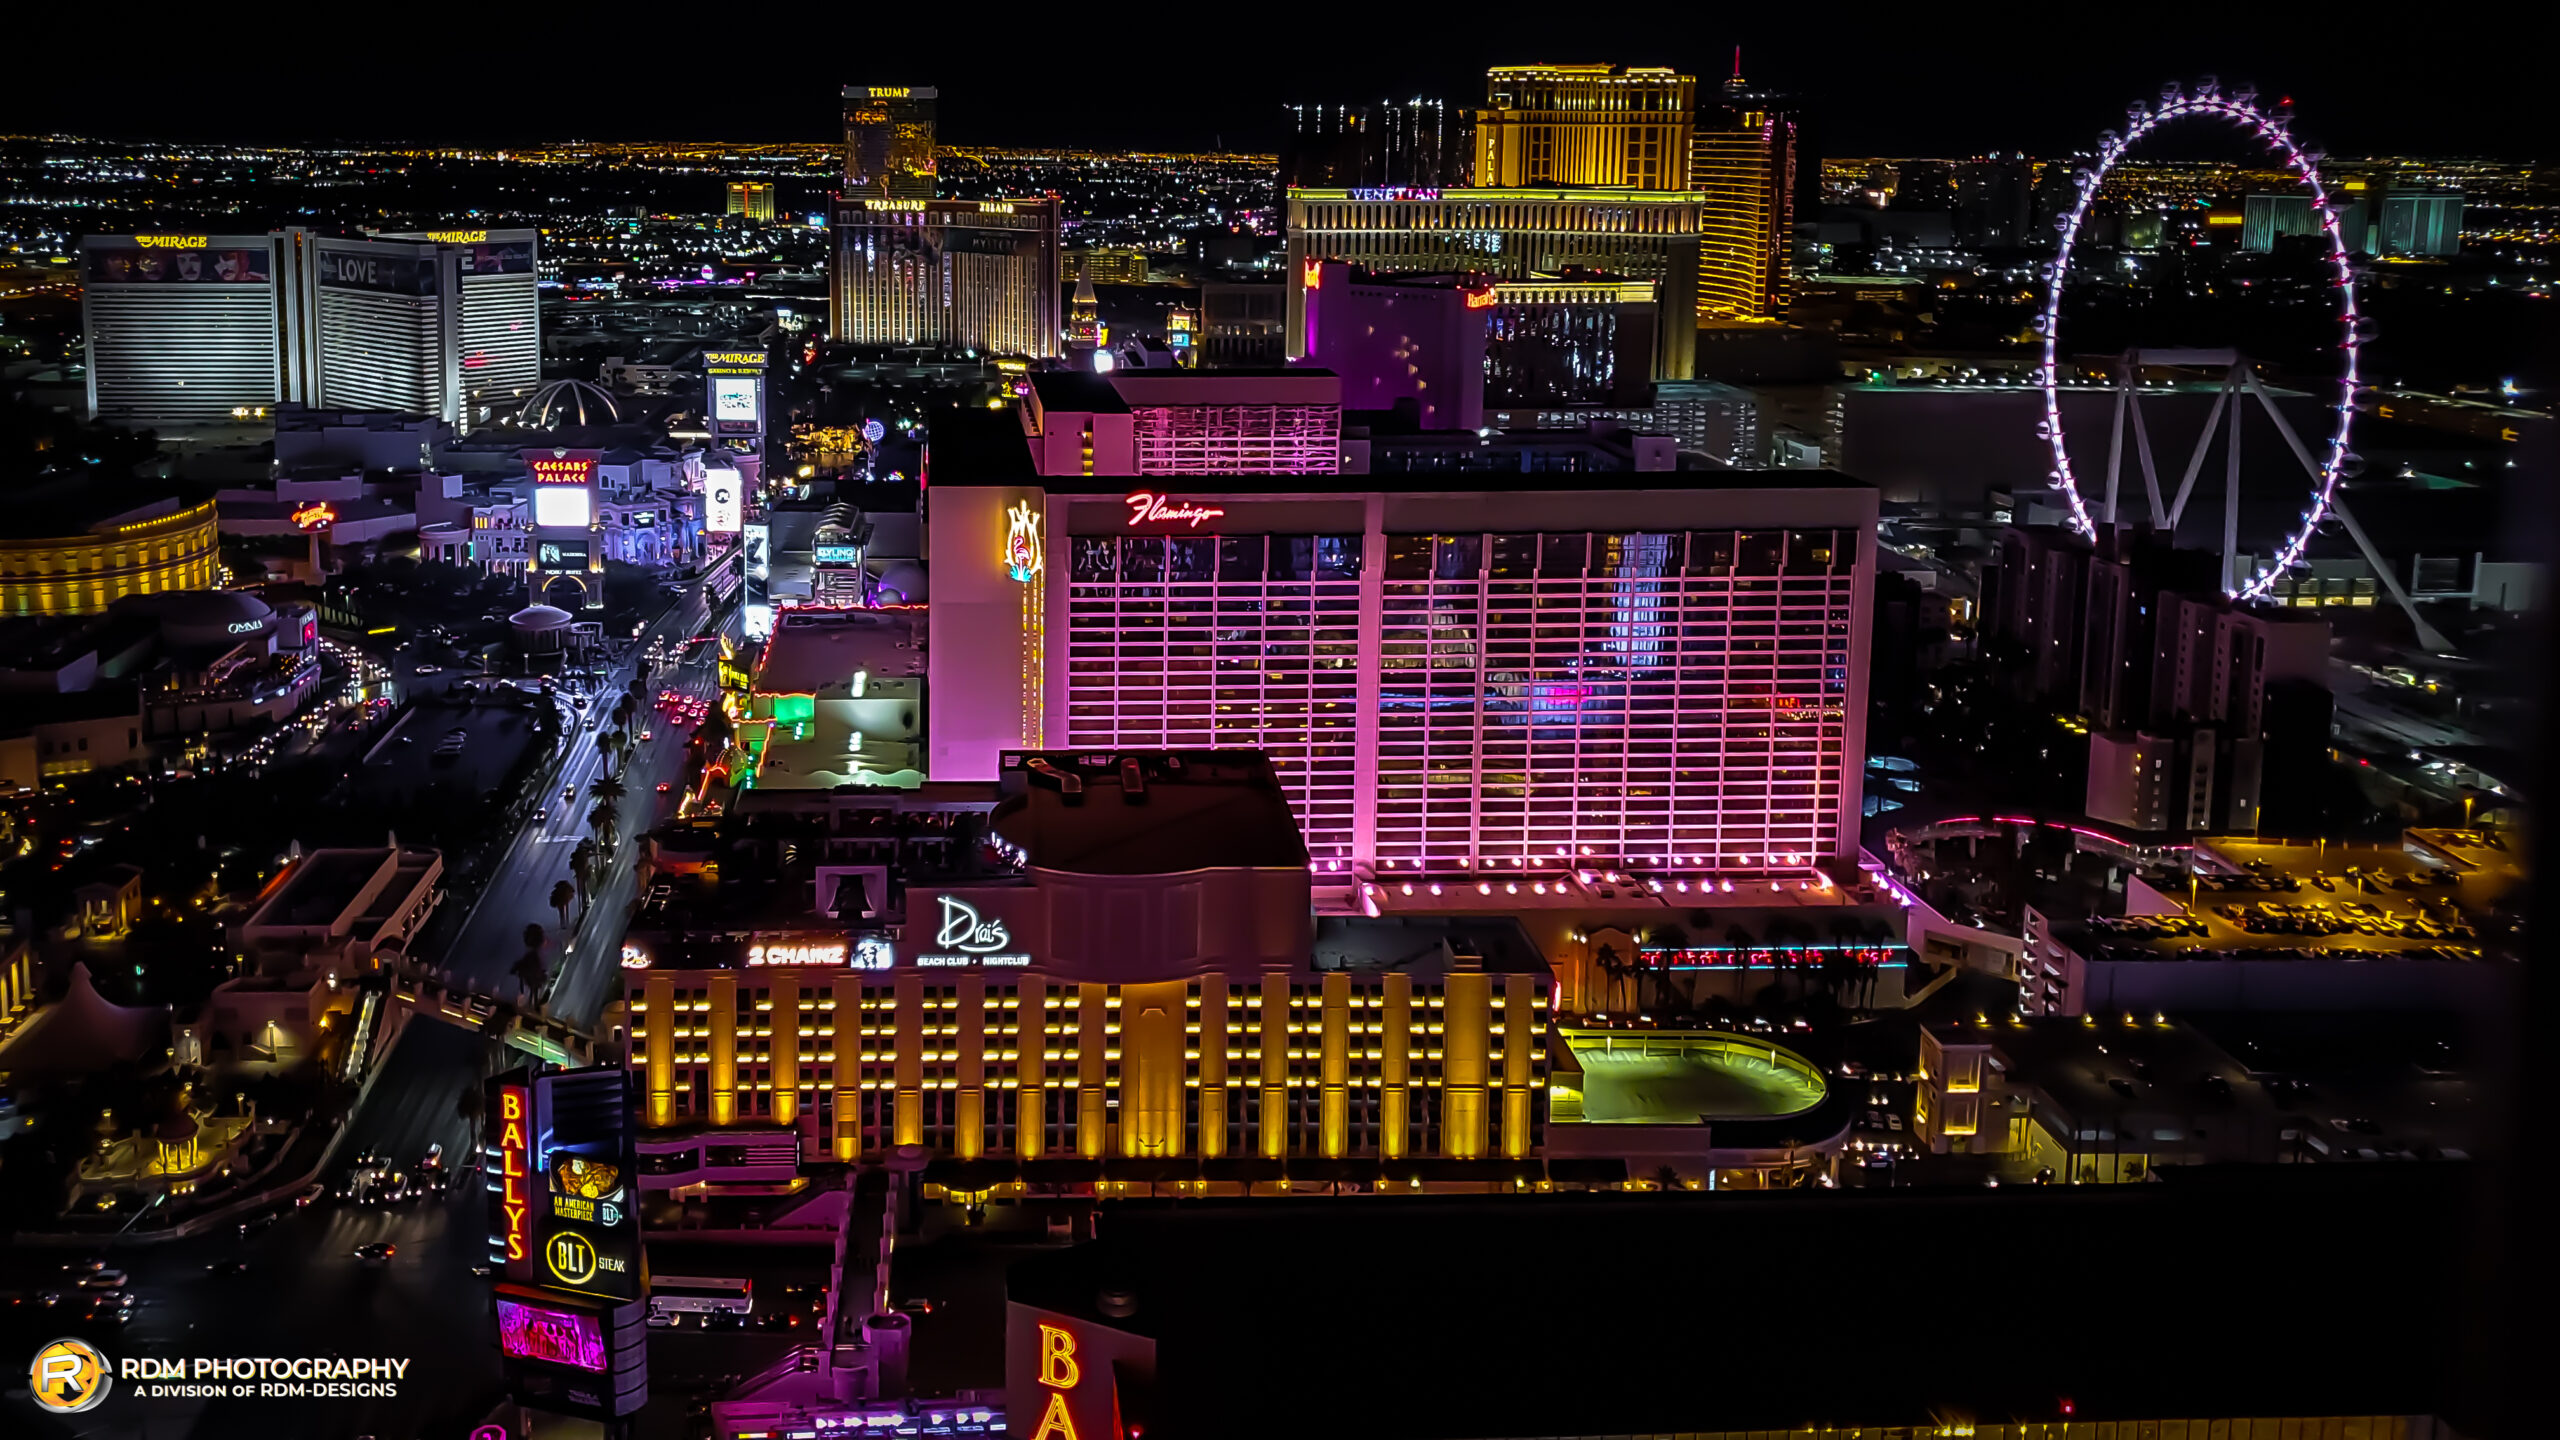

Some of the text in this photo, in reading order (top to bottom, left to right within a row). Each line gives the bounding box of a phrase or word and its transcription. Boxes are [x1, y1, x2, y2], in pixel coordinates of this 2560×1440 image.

[868, 87, 910, 97] TRUMP
[1486, 138, 1495, 186] PALA
[1352, 187, 1438, 200] VENETIAN
[865, 199, 926, 211] TREASURE
[148, 236, 207, 249] MIRAGE
[438, 231, 487, 243] MIRAGE
[338, 258, 377, 284] LOVE
[717, 353, 765, 364] MIRAGE
[534, 461, 588, 472] CAESARS
[537, 473, 586, 482] PALACE
[1126, 493, 1224, 528] Flamingo
[228, 619, 263, 633] OMNIA
[937, 896, 1008, 952] Drai's
[749, 945, 845, 964] 2 CHAINZ
[917, 956, 1030, 966] BEACH CLUB NIGHTCLUB
[501, 1093, 524, 1260] BALLYS
[564, 1197, 594, 1212] AMERICAN
[554, 1206, 594, 1221] MASTERPIECE
[557, 1241, 585, 1273] BLT
[598, 1257, 625, 1273] STEAK
